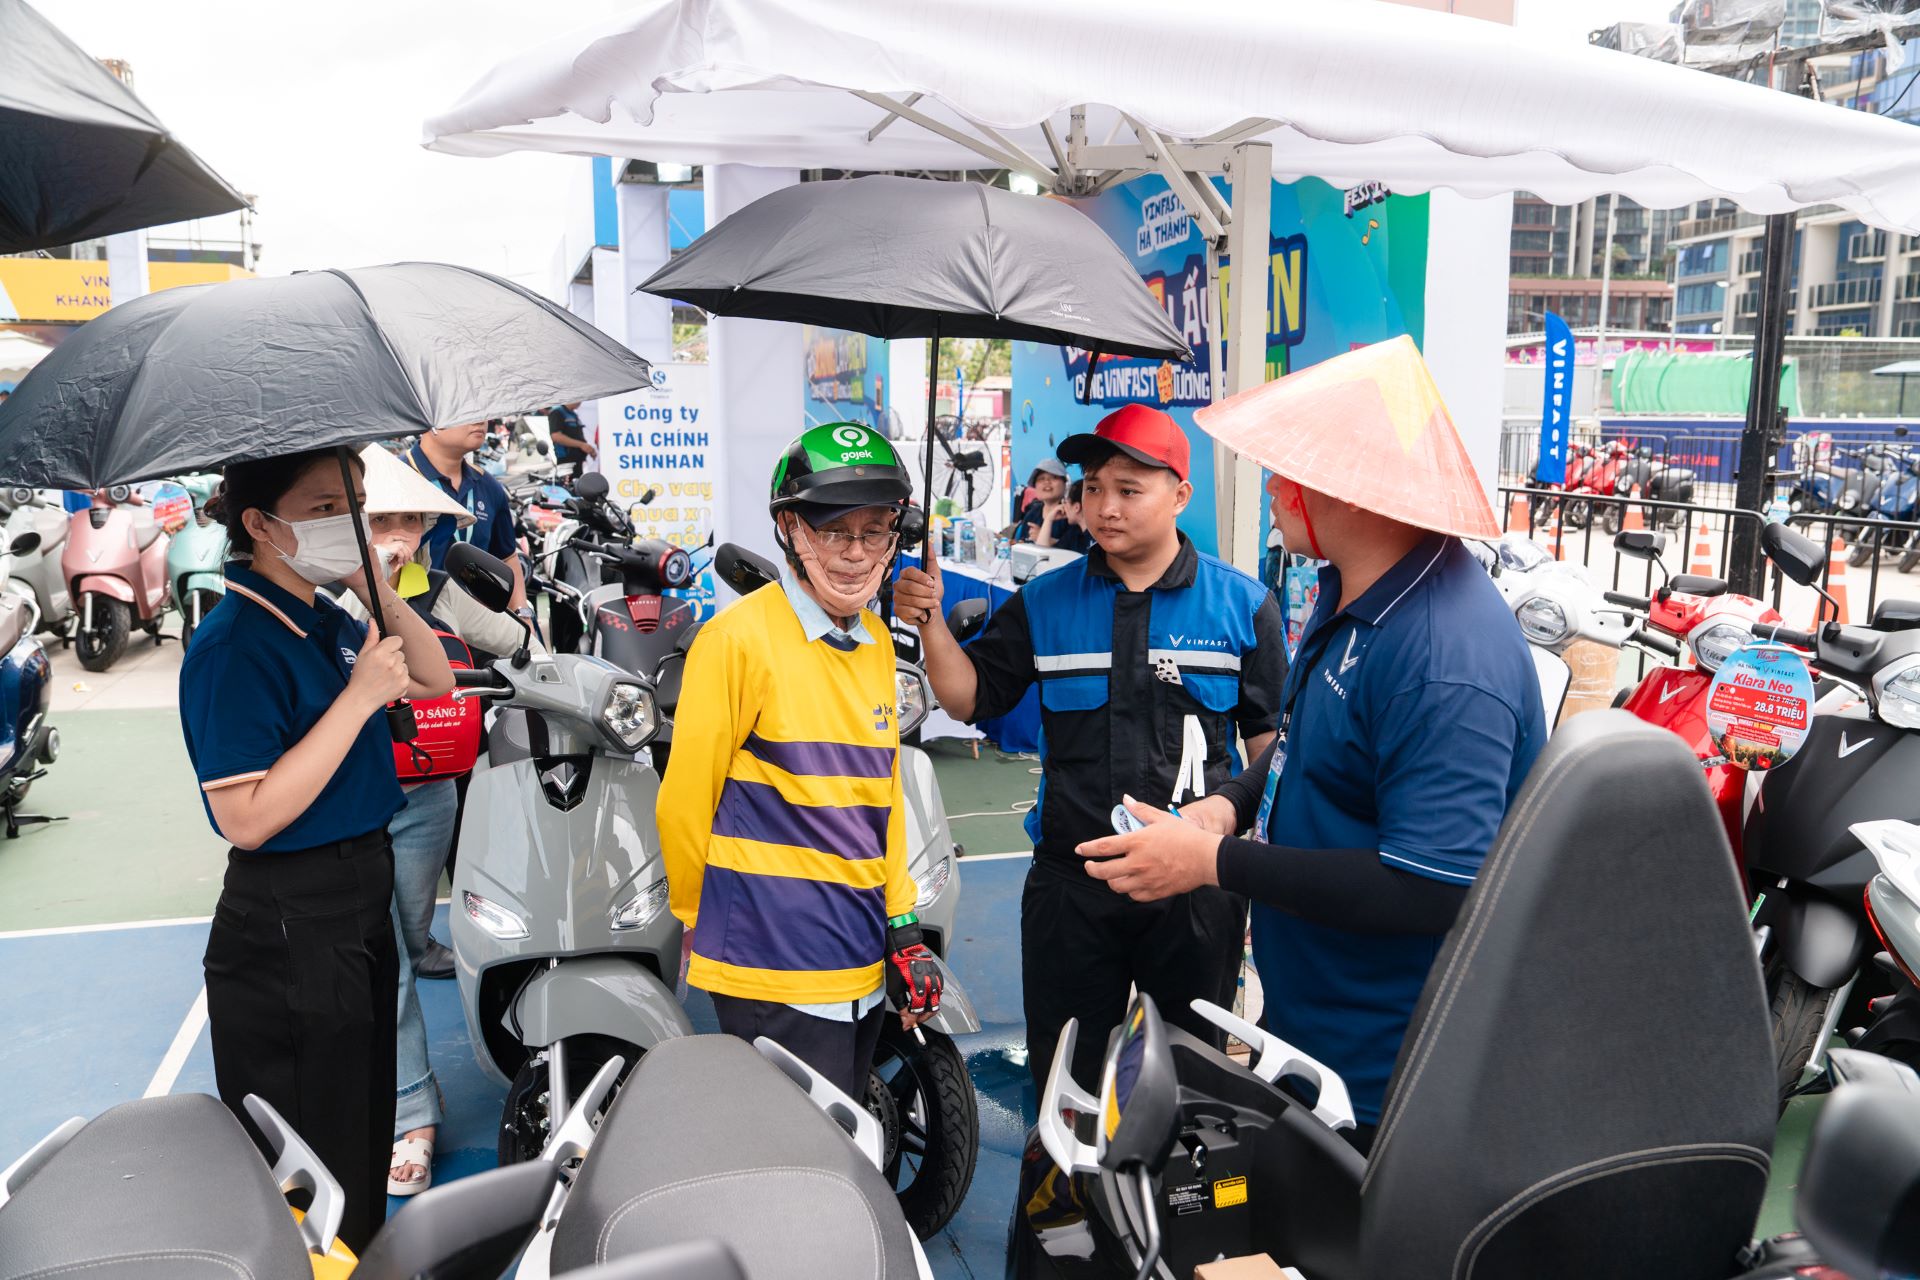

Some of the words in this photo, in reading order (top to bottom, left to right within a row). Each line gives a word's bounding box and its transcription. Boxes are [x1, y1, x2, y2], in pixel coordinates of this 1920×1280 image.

[1139, 224, 1152, 251] HÀ
[1154, 216, 1187, 245] THÀNH
[1075, 371, 1104, 400] CNG
[1550, 338, 1567, 460] VINFAST
[624, 404, 673, 424] Công
[680, 406, 699, 423] ty
[612, 428, 643, 447] TÀI
[650, 428, 709, 447] CHÍNH
[619, 454, 704, 469] SHINHAN
[840, 449, 873, 462] gojek
[617, 479, 665, 498] Cho
[668, 482, 714, 501] vay
[1186, 639, 1228, 648] VINFAST
[1733, 672, 1766, 690] Klara
[1768, 678, 1794, 695] Neo
[427, 706, 457, 719] SÁNG
[459, 706, 467, 717] 2
[1754, 701, 1774, 714] 28.8
[1776, 705, 1805, 721] TRIỆU
